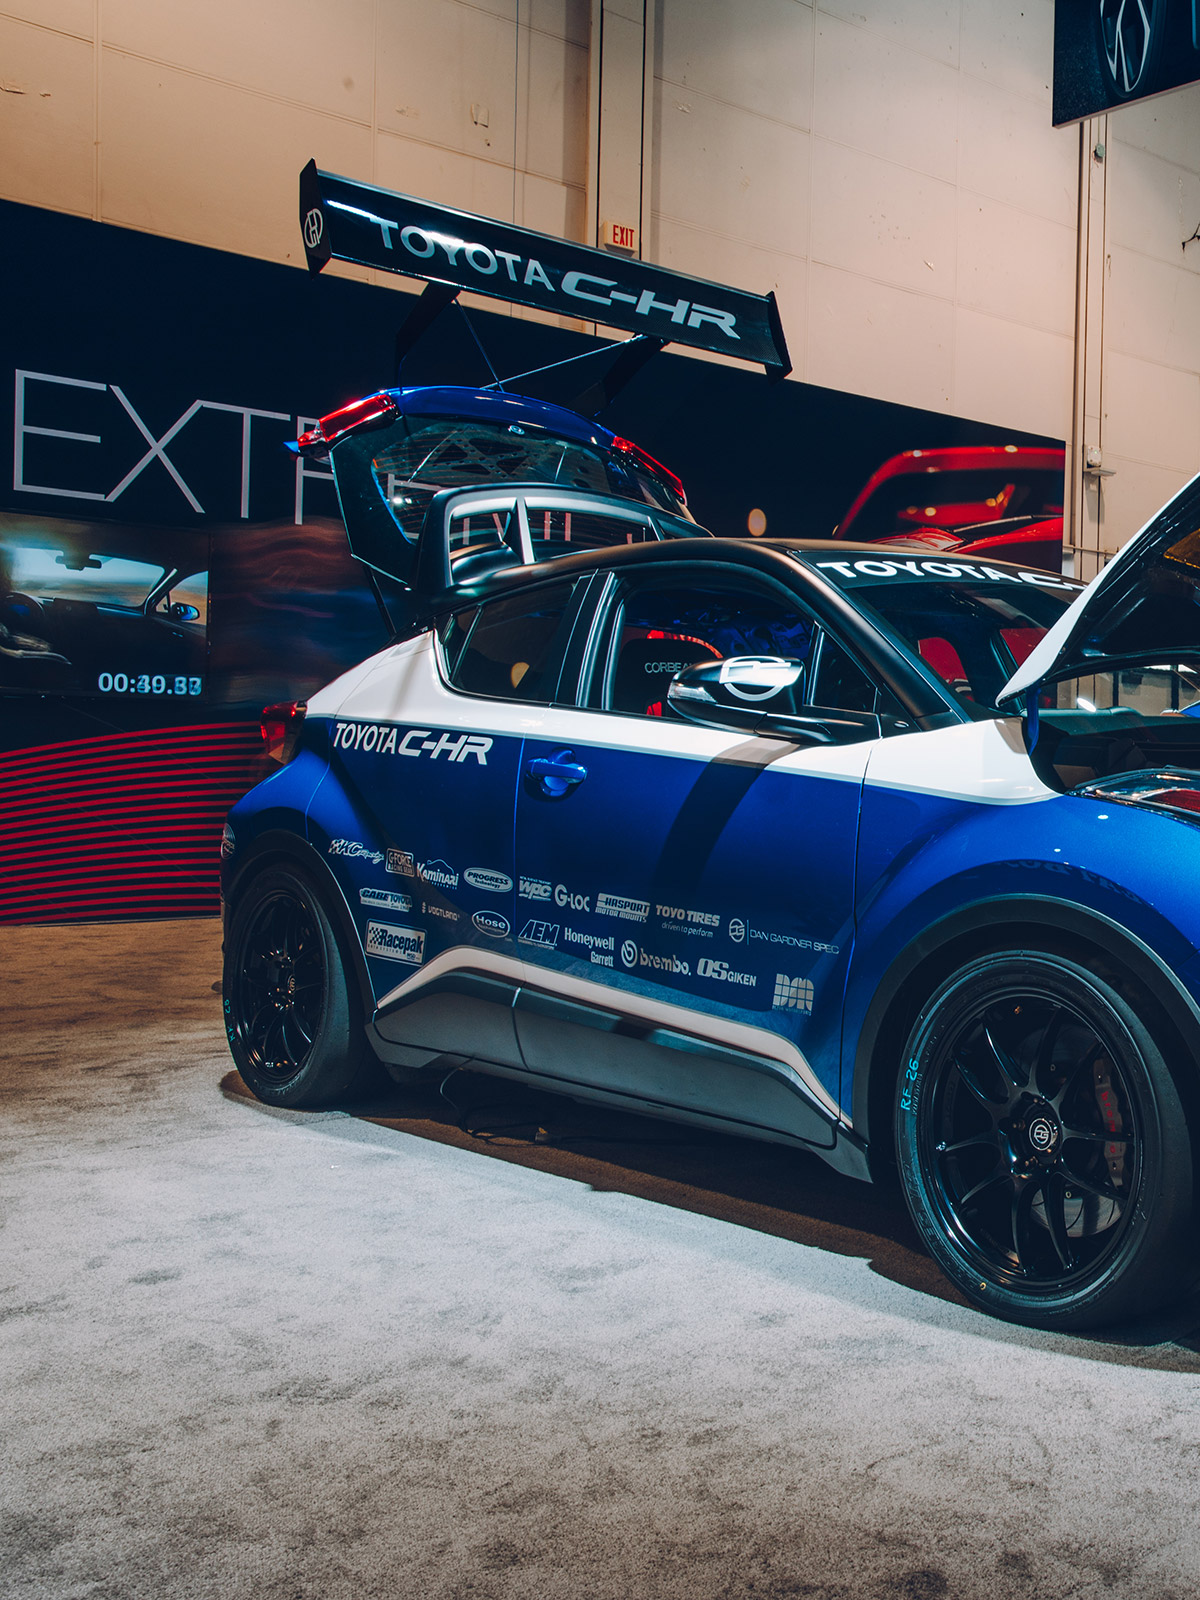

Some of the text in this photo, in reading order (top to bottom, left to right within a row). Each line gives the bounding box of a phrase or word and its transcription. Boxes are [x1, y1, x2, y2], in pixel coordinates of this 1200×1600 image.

[612, 224, 635, 249] EXIT
[369, 215, 741, 339] TOYOTA C-HR
[816, 560, 1023, 583] TOYOTA
[333, 723, 494, 765] TOYOTA C-HR
[467, 871, 508, 886] PROGRESS
[554, 884, 590, 912] G-LOC
[604, 896, 650, 915] HASPORT
[475, 914, 506, 929] Hose
[656, 904, 721, 927] TOYO TIRES
[379, 928, 424, 954] Racepak
[518, 919, 560, 946] AEM
[564, 927, 615, 951] Honeywell
[661, 921, 714, 938] driven to perform
[750, 929, 840, 954] DAN GARDNER SPEC
[590, 951, 614, 967] Garrett
[697, 957, 757, 987] OS GIKEN
[900, 1087, 912, 1111] RF
[906, 1058, 919, 1081] 26
[1101, 1091, 1116, 1153] bremo
